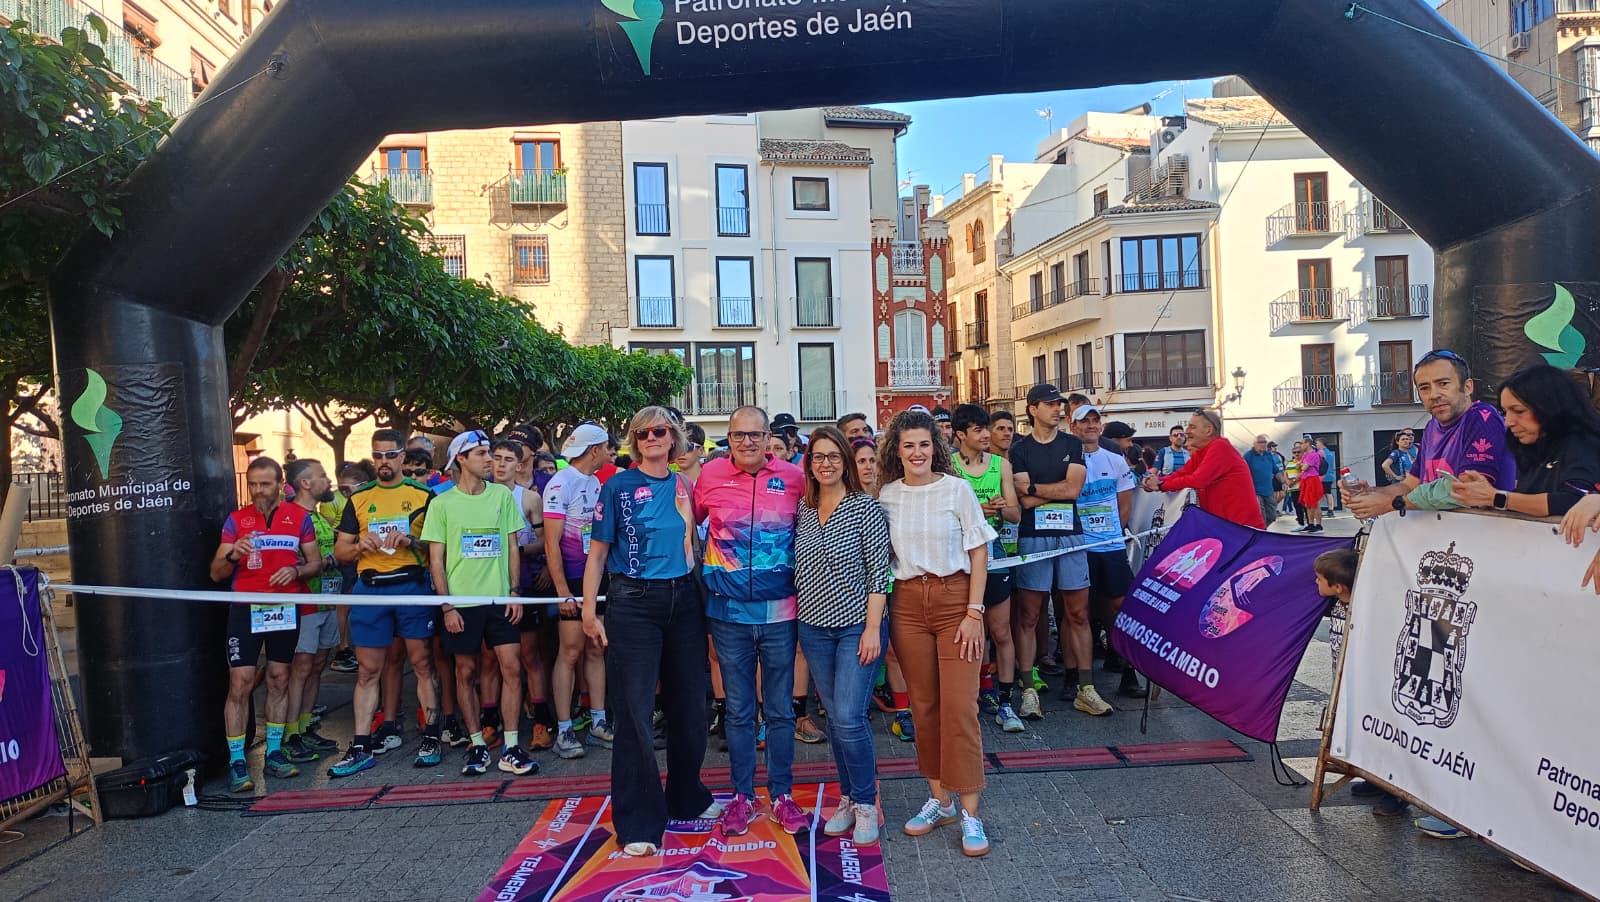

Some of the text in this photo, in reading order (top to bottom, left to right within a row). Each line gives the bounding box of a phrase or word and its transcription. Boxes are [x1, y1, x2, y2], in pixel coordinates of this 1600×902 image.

[675, 0, 800, 13] Patro
[677, 5, 911, 48] Deportes de Jaén
[1145, 421, 1165, 429] PADRE
[99, 480, 168, 497] Municipal
[173, 479, 191, 491] de
[68, 495, 173, 518] Deportes de Jaén
[1046, 513, 1062, 521] 421
[1089, 516, 1105, 524] 397
[260, 539, 294, 547] Avanza
[474, 539, 492, 548] 427
[264, 612, 283, 622] 240
[1362, 714, 1475, 781] CIUDAD DE JAÉN
[1537, 757, 1600, 801] Patrona
[1553, 791, 1600, 830] Depo
[493, 856, 542, 902] TEAMERG
